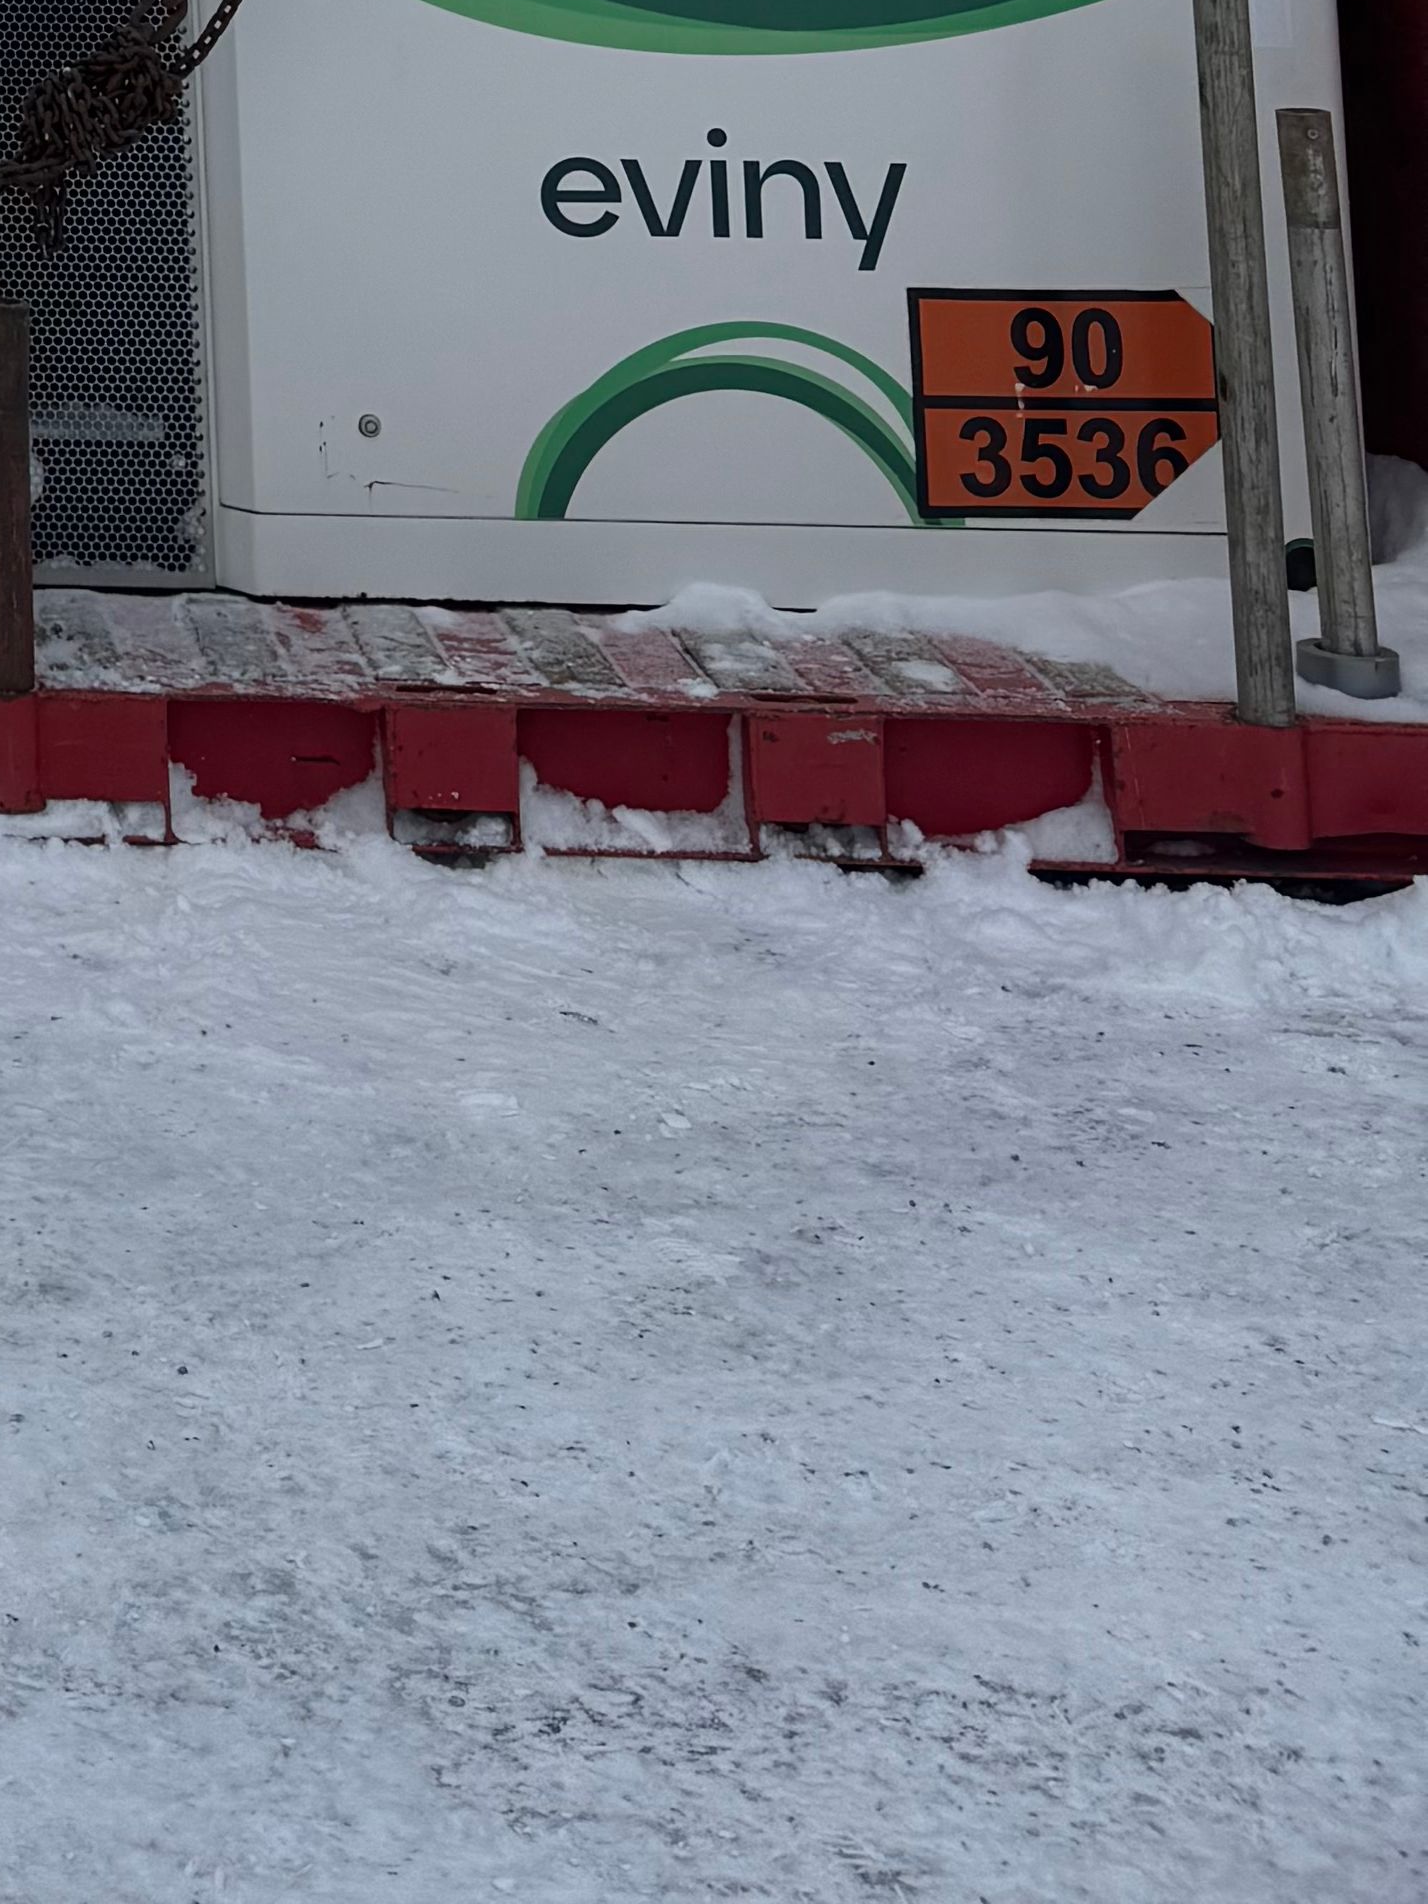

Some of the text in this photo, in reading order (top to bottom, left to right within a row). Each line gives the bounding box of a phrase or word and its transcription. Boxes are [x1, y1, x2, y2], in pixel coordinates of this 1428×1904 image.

[540, 127, 907, 271] eviny
[1009, 306, 1124, 391] 90
[958, 416, 1190, 500] 3536
